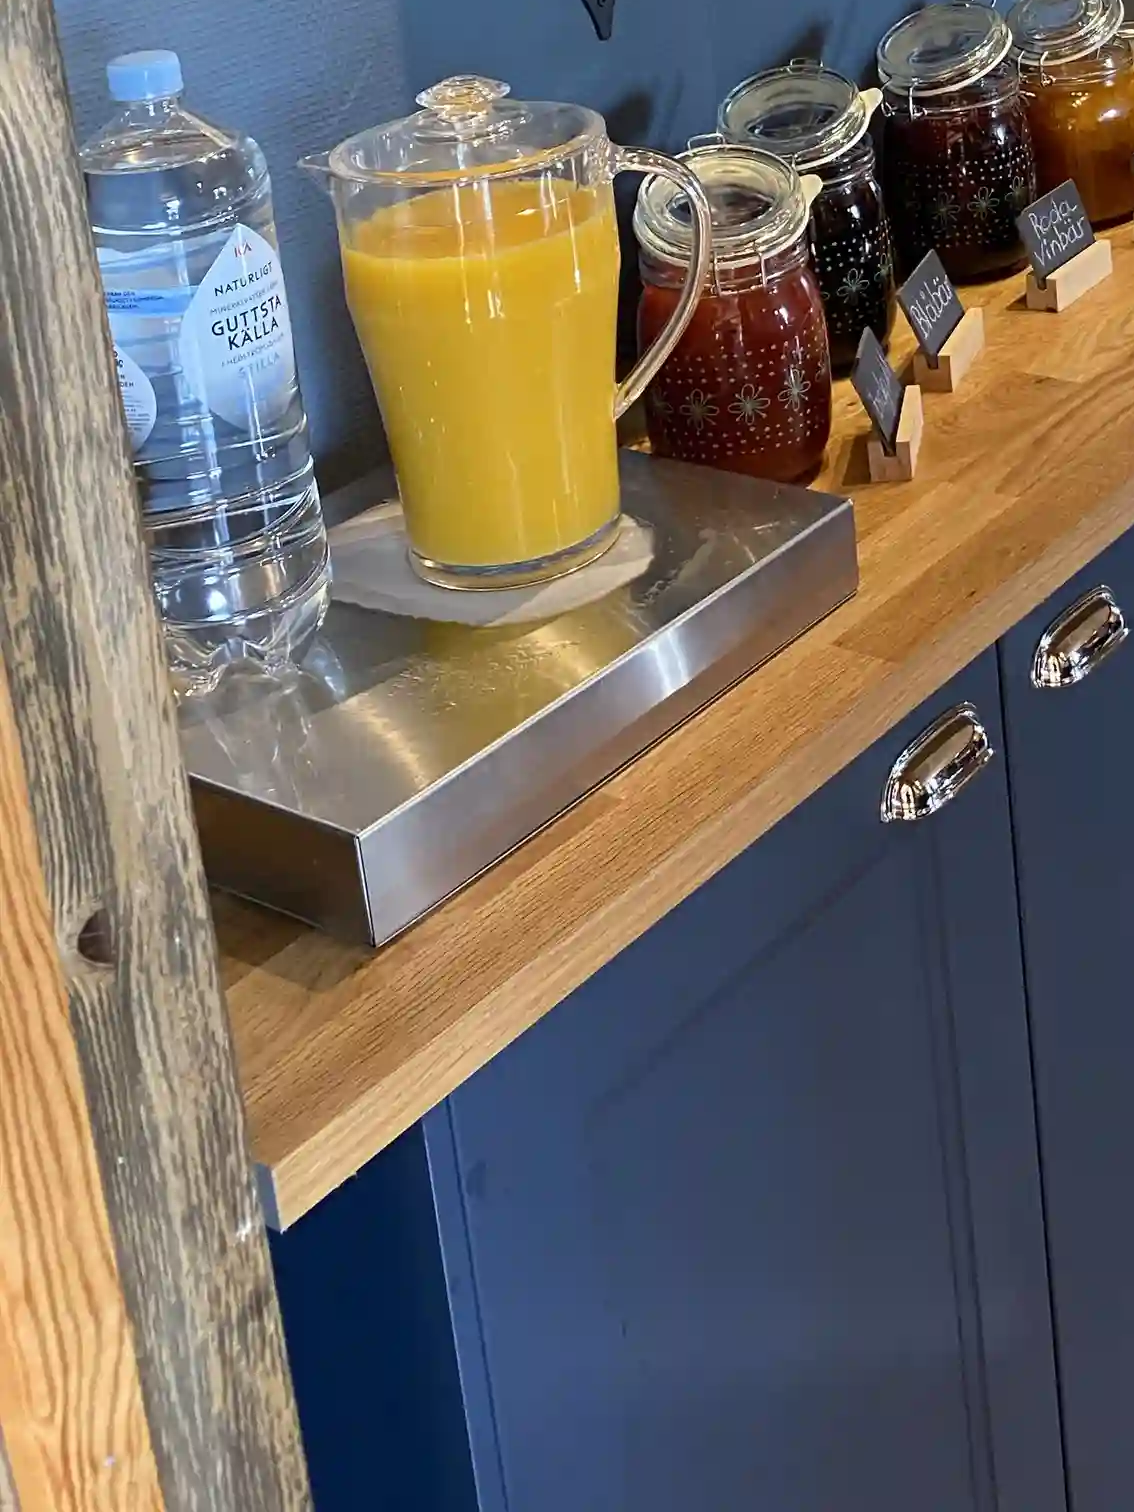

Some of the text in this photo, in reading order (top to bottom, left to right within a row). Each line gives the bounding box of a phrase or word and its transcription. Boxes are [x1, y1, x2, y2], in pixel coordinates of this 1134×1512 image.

[214, 261, 272, 296] NATURLIGT
[211, 295, 282, 336] GUTTSTA
[228, 316, 279, 350] KÄLLA
